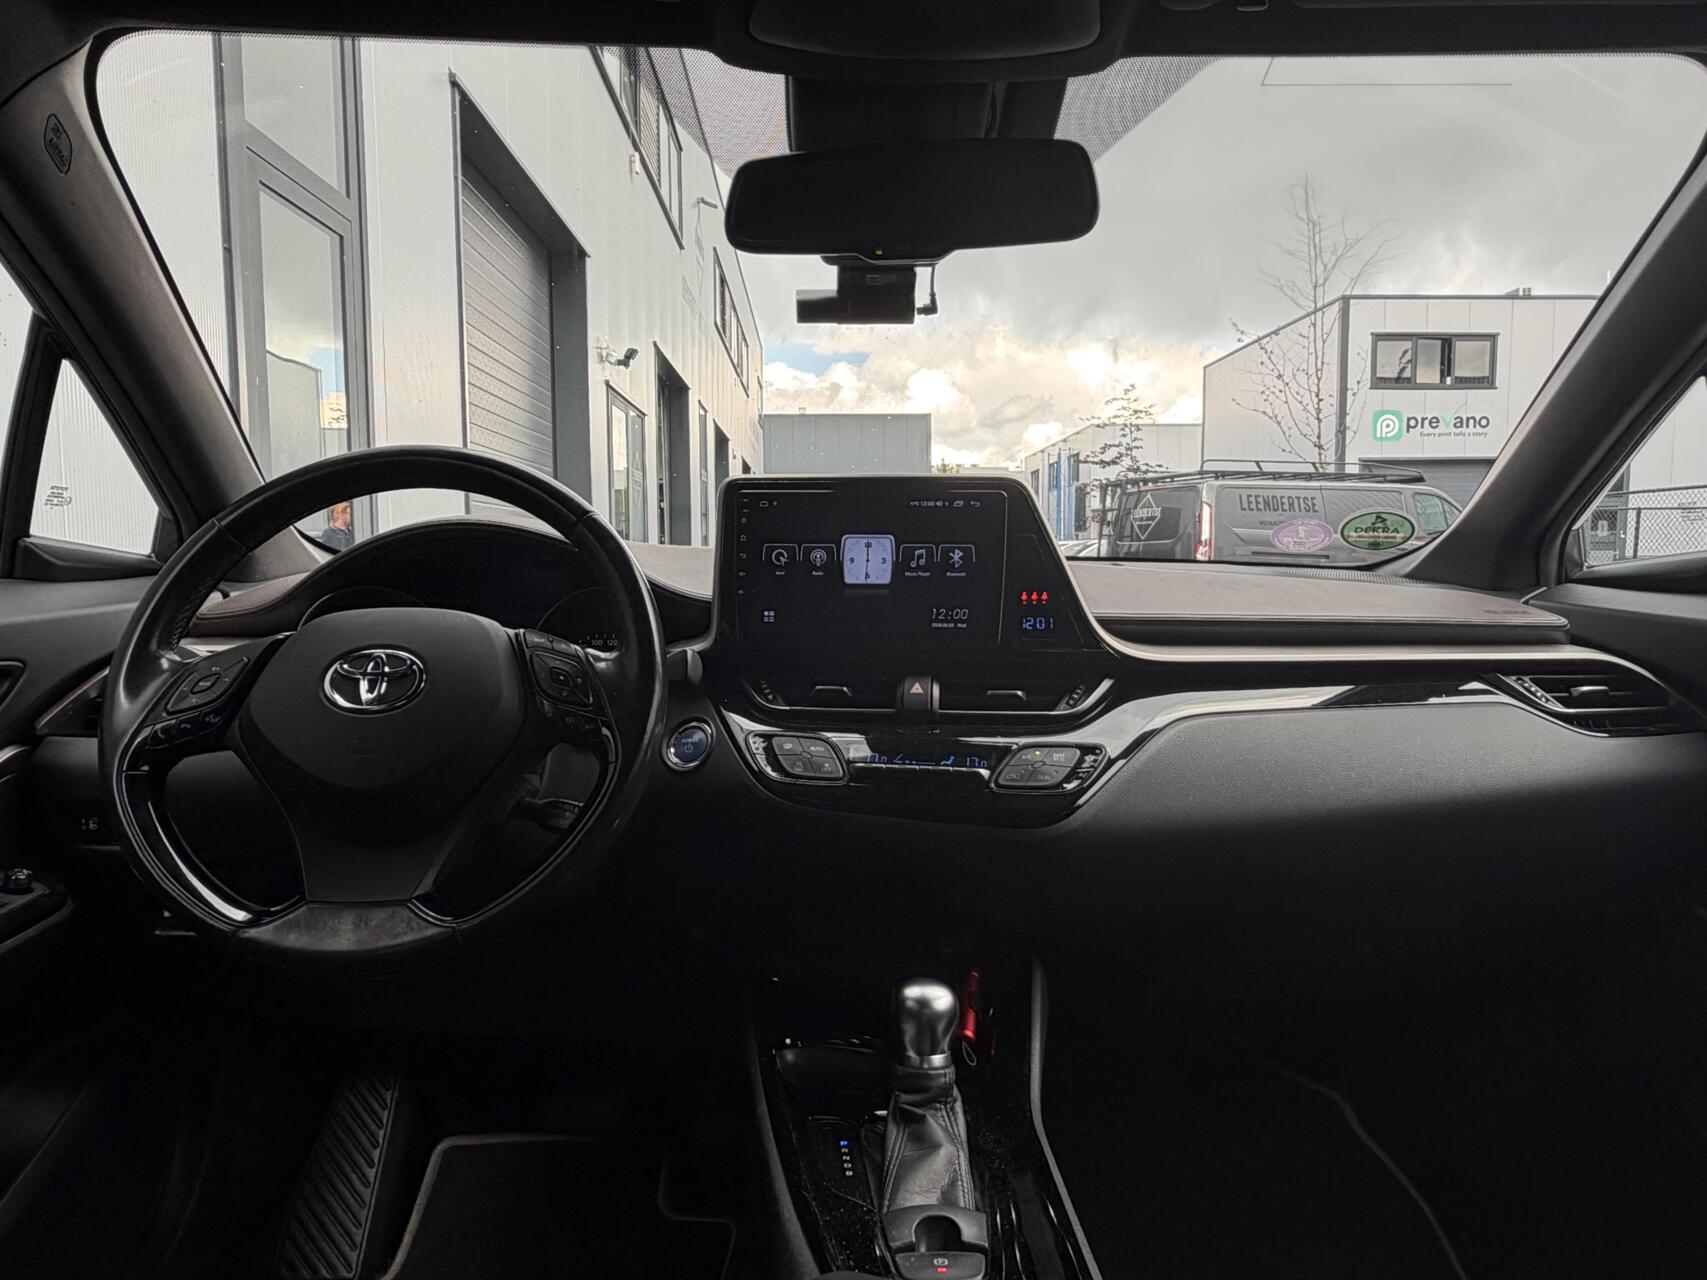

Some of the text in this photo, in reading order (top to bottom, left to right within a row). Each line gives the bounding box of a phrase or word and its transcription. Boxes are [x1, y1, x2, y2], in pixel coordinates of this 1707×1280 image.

[1238, 494, 1320, 513] LEENDERTSE
[1354, 526, 1400, 534] DEKRA
[932, 608, 969, 620] 12:00
